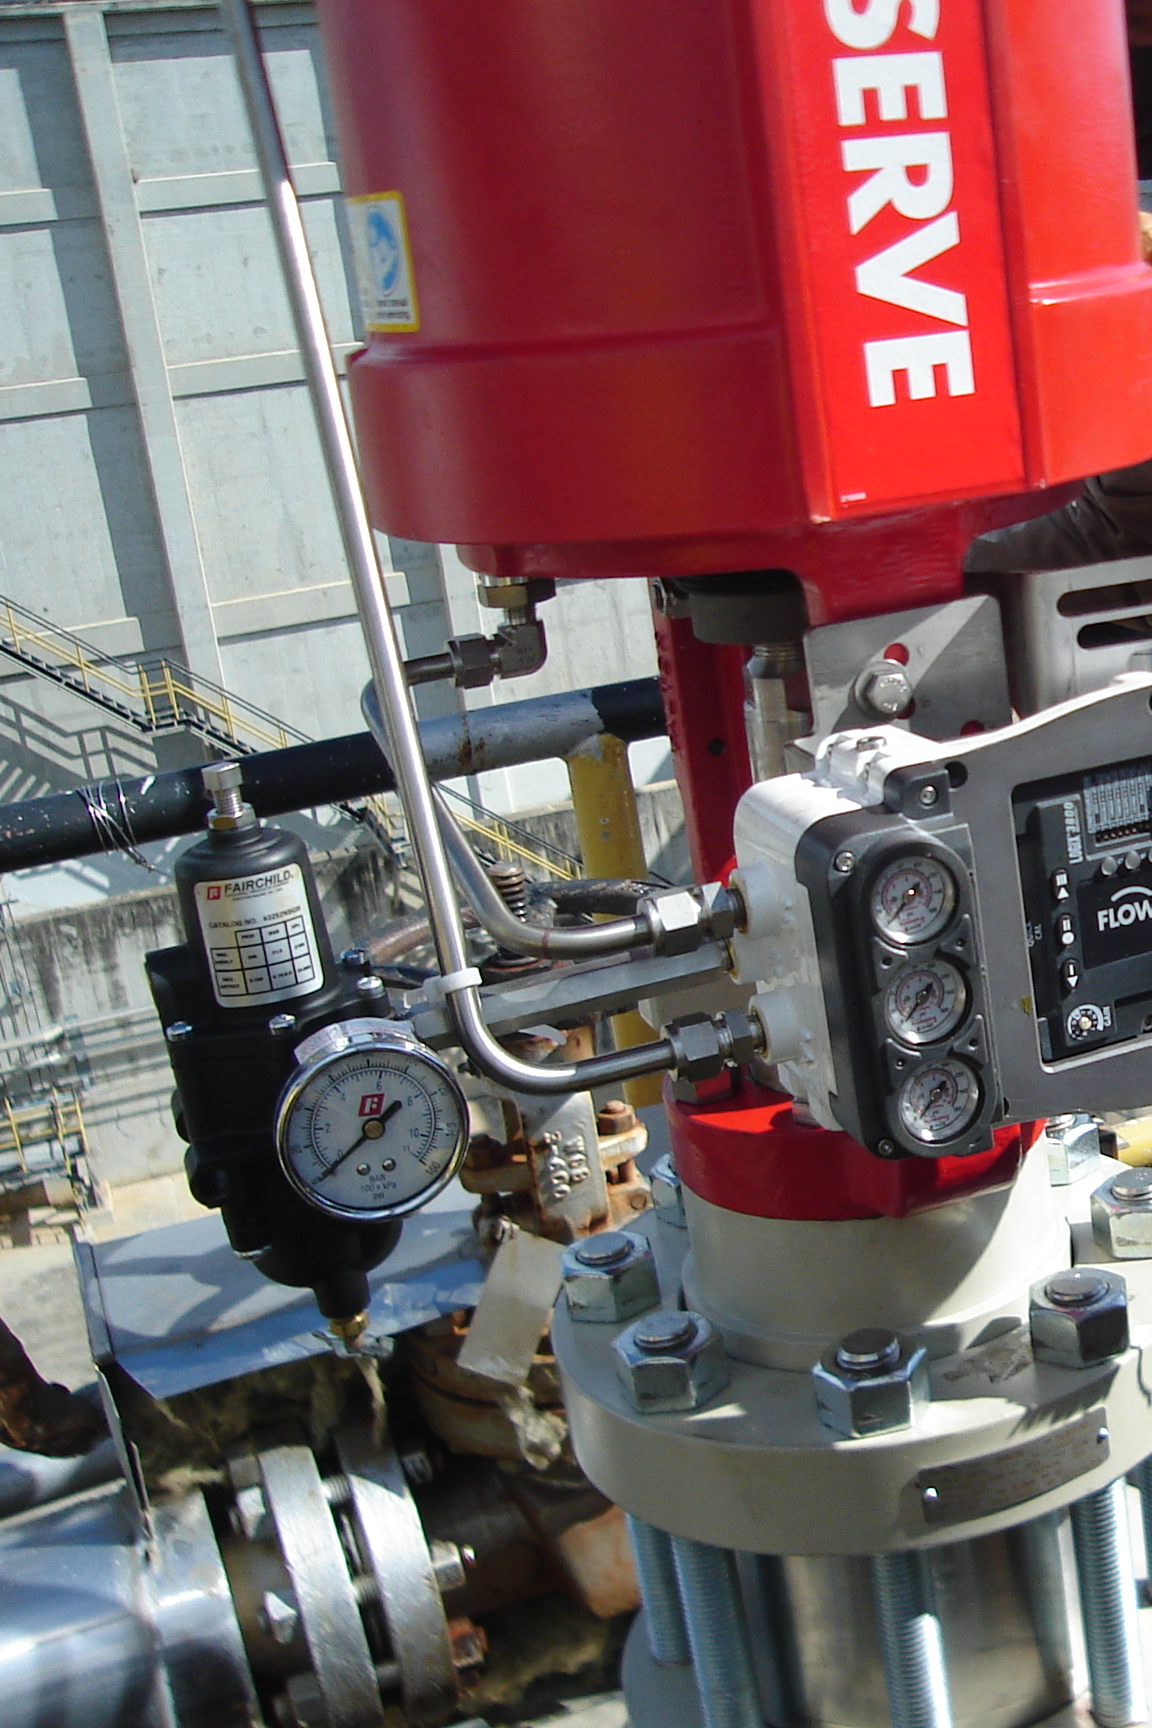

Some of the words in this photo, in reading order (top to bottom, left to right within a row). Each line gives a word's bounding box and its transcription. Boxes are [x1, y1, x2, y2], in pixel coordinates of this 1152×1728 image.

[224, 870, 292, 894] FAIRCHILD
[325, 1123, 331, 1133] 2
[410, 1128, 419, 1138] 10
